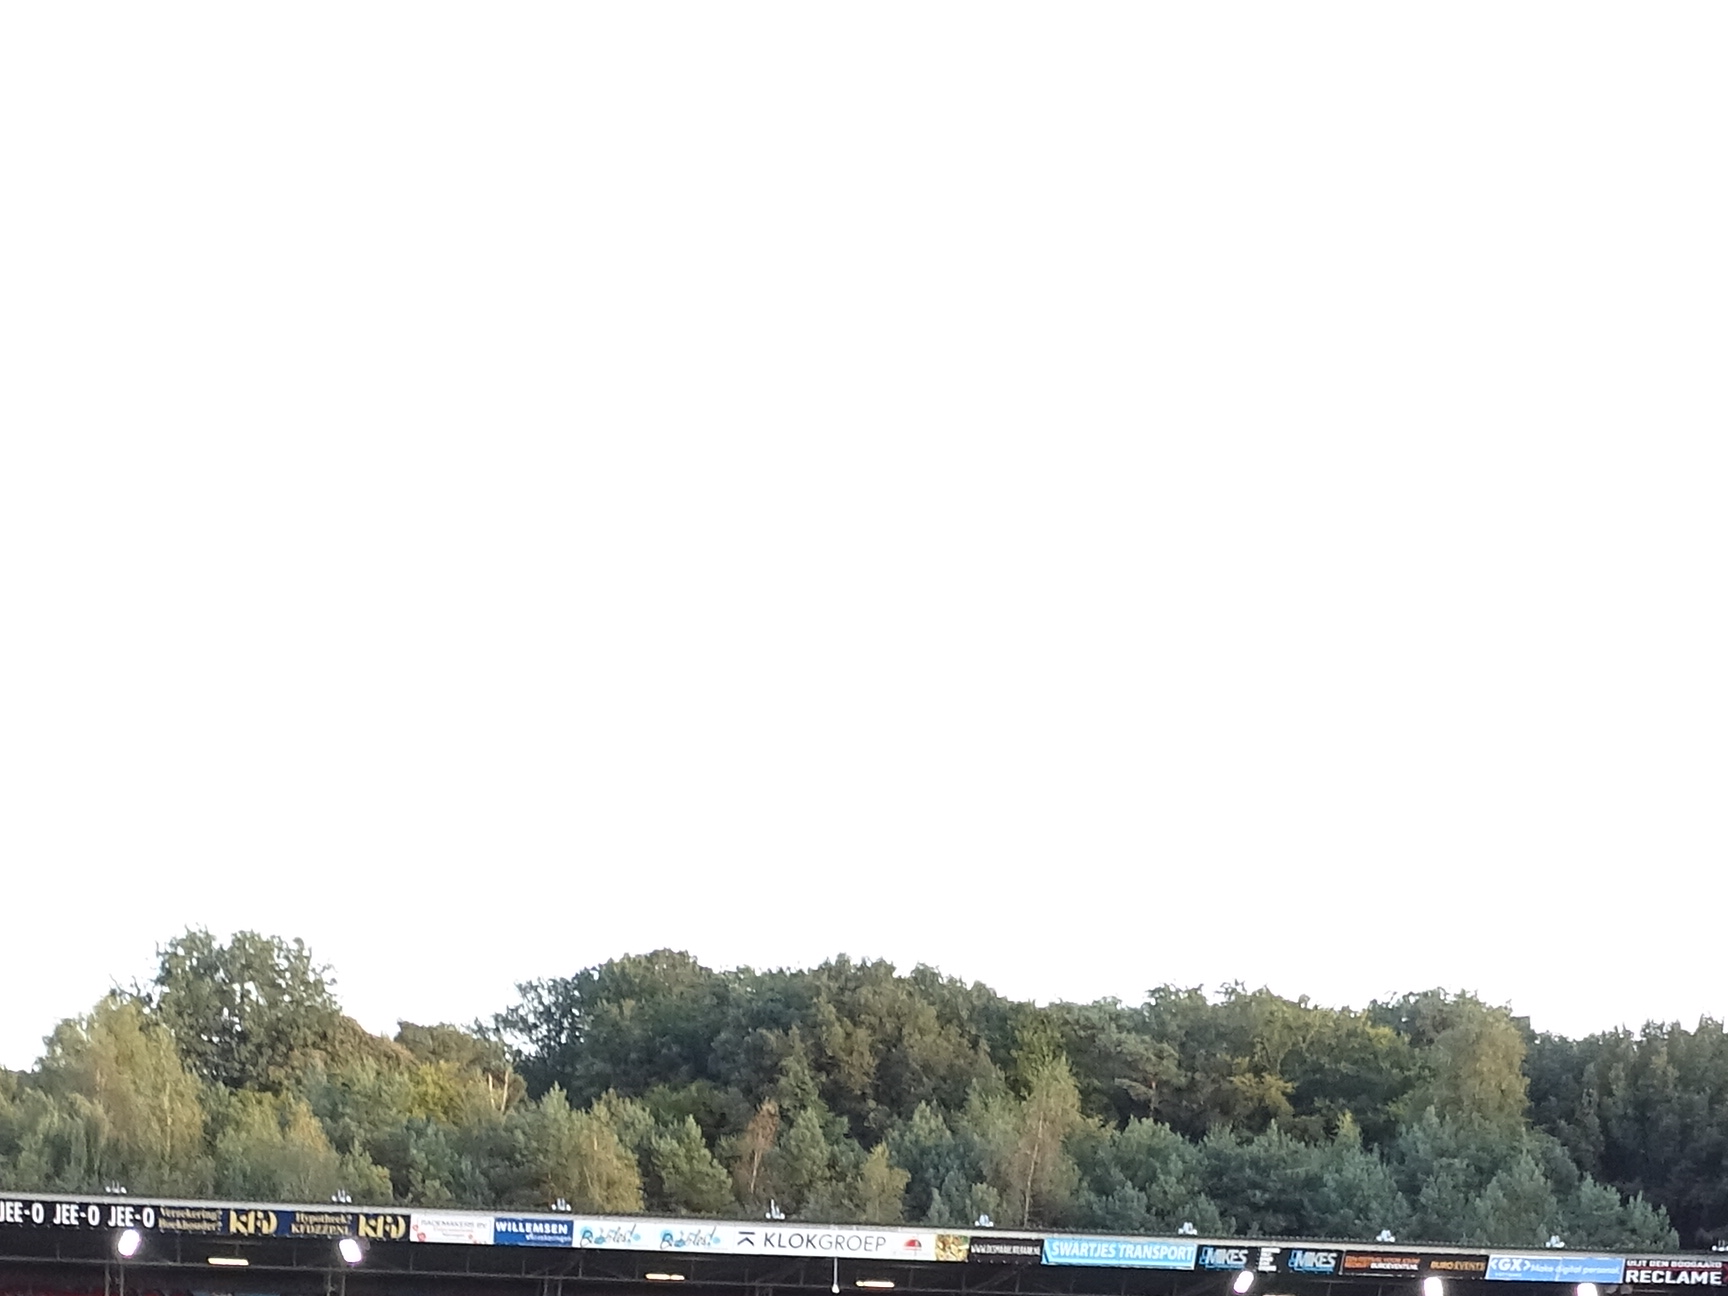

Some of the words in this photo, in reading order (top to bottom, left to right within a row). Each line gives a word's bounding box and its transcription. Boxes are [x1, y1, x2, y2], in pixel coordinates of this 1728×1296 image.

[52, 1202, 100, 1228] JEE-O
[107, 1204, 156, 1229] JEE-O
[495, 1221, 568, 1234] WILLEMSEN
[763, 1232, 886, 1252] KLOKGROEP
[1051, 1240, 1116, 1258] SWARTJES
[1118, 1242, 1194, 1260] TRANSPORT
[1205, 1248, 1249, 1267] MIKES
[1293, 1251, 1337, 1269] MIKES
[1625, 1269, 1723, 1284] RECLAME
